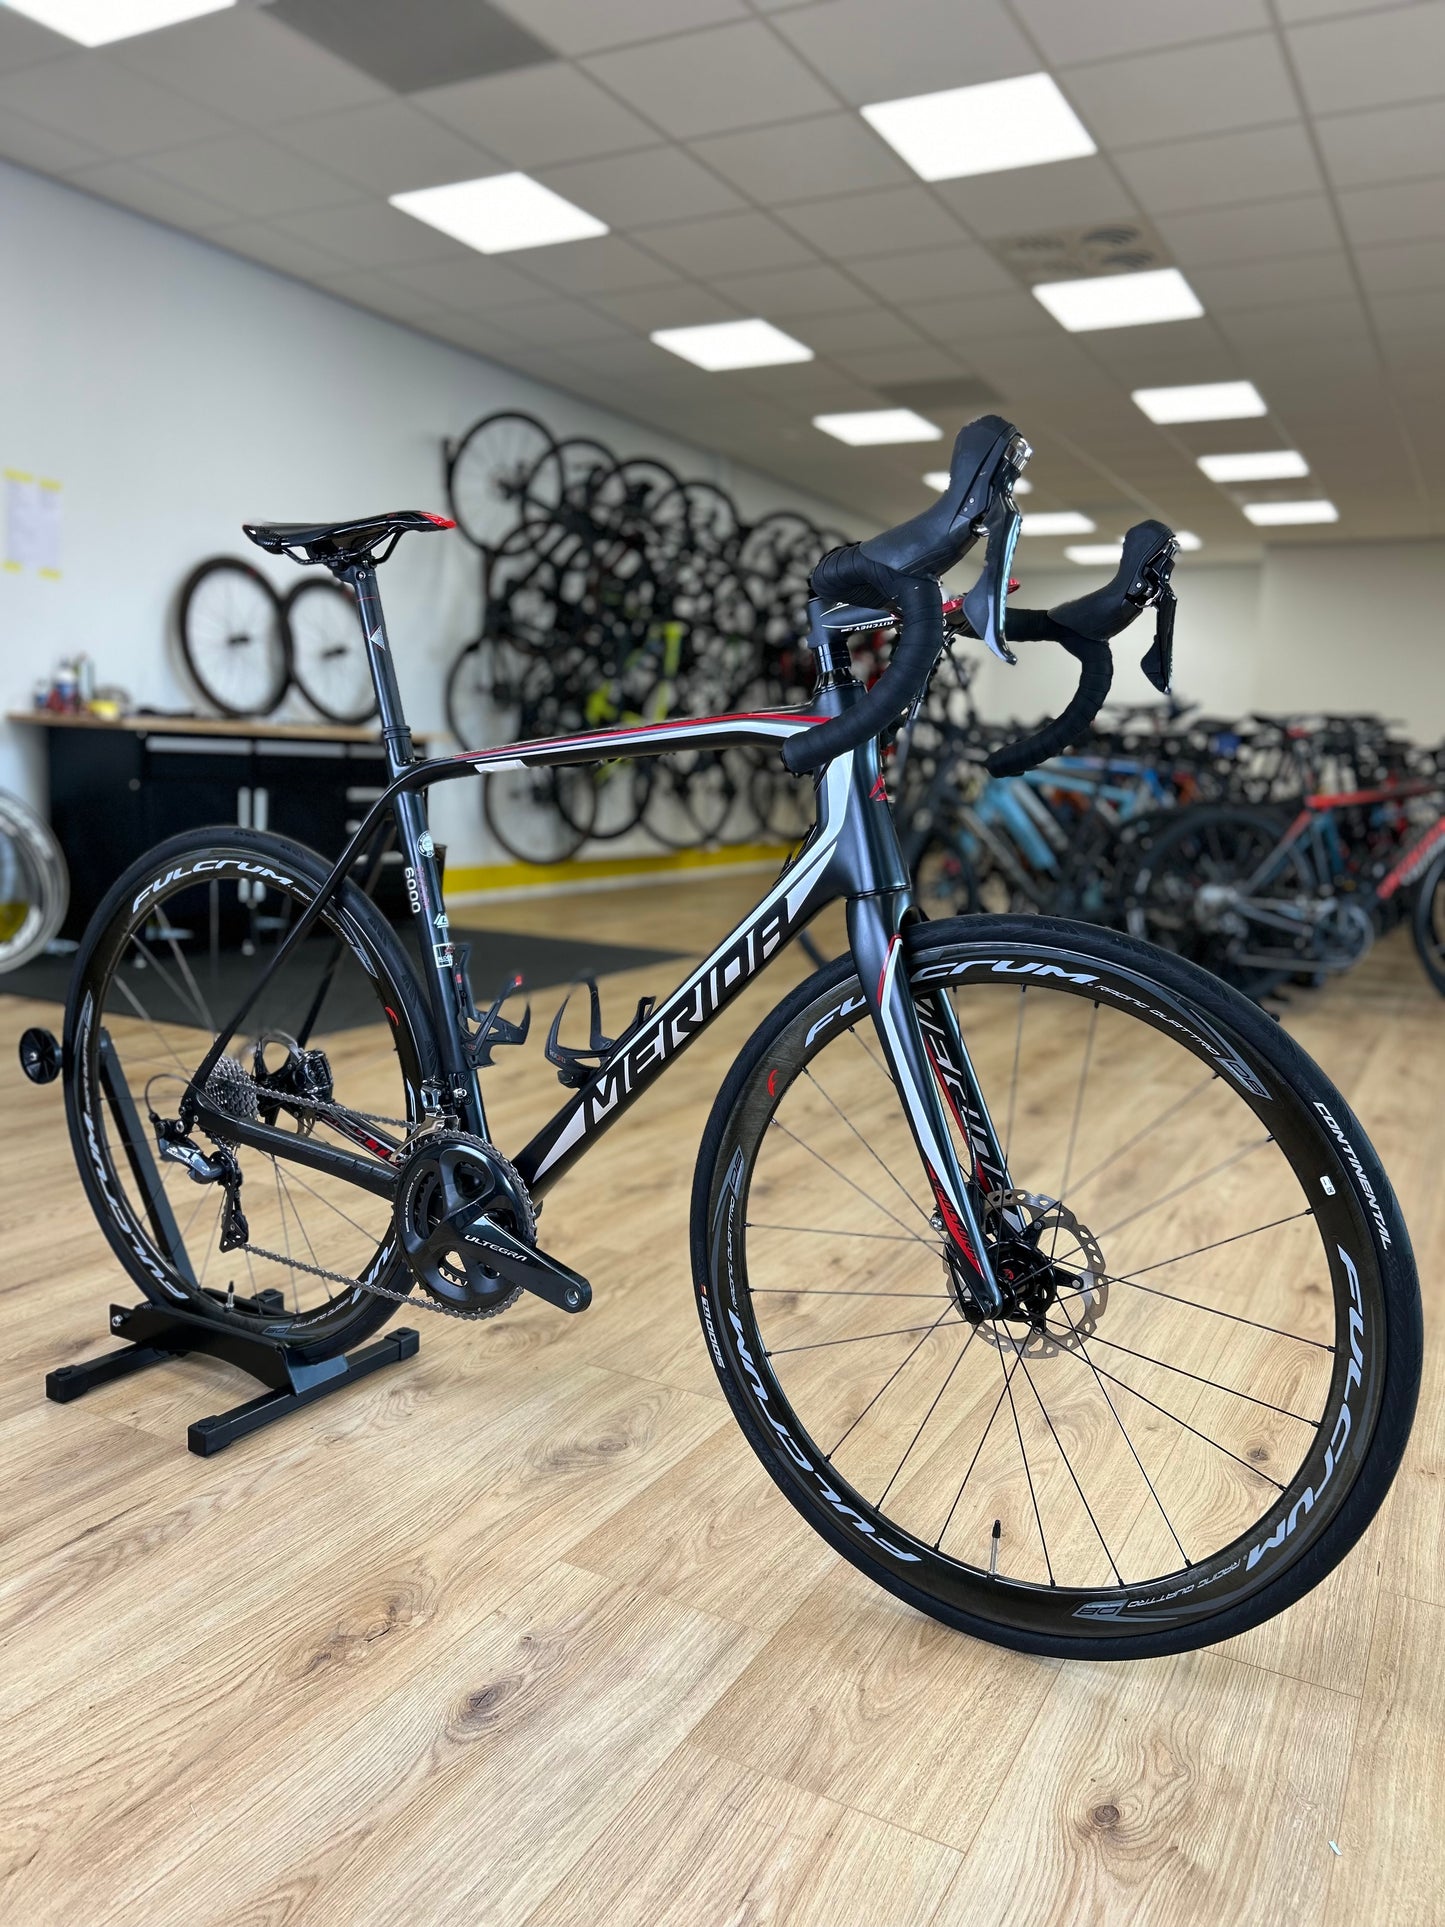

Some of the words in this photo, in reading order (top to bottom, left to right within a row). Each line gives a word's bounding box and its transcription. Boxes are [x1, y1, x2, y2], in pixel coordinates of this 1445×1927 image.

[854, 620, 894, 632] RITCHEY
[132, 859, 294, 914] FULCRUM
[404, 866, 422, 914] 6000
[585, 908, 795, 1130] MERIDA
[804, 960, 1100, 1049] FUCRUM
[1095, 985, 1150, 1010] RACING
[1149, 1009, 1221, 1056] QUATTRO
[1312, 1101, 1393, 1251] CONTINENTAL
[83, 1111, 190, 1299] FULCRUM
[464, 1233, 529, 1262] ULTEGRA
[705, 1318, 726, 1369] 5000
[1245, 1242, 1365, 1572] FULCRUM
[727, 1308, 923, 1562] FULCRUM
[1126, 1584, 1196, 1608] QUATTRO
[1197, 1558, 1242, 1589] RACING
